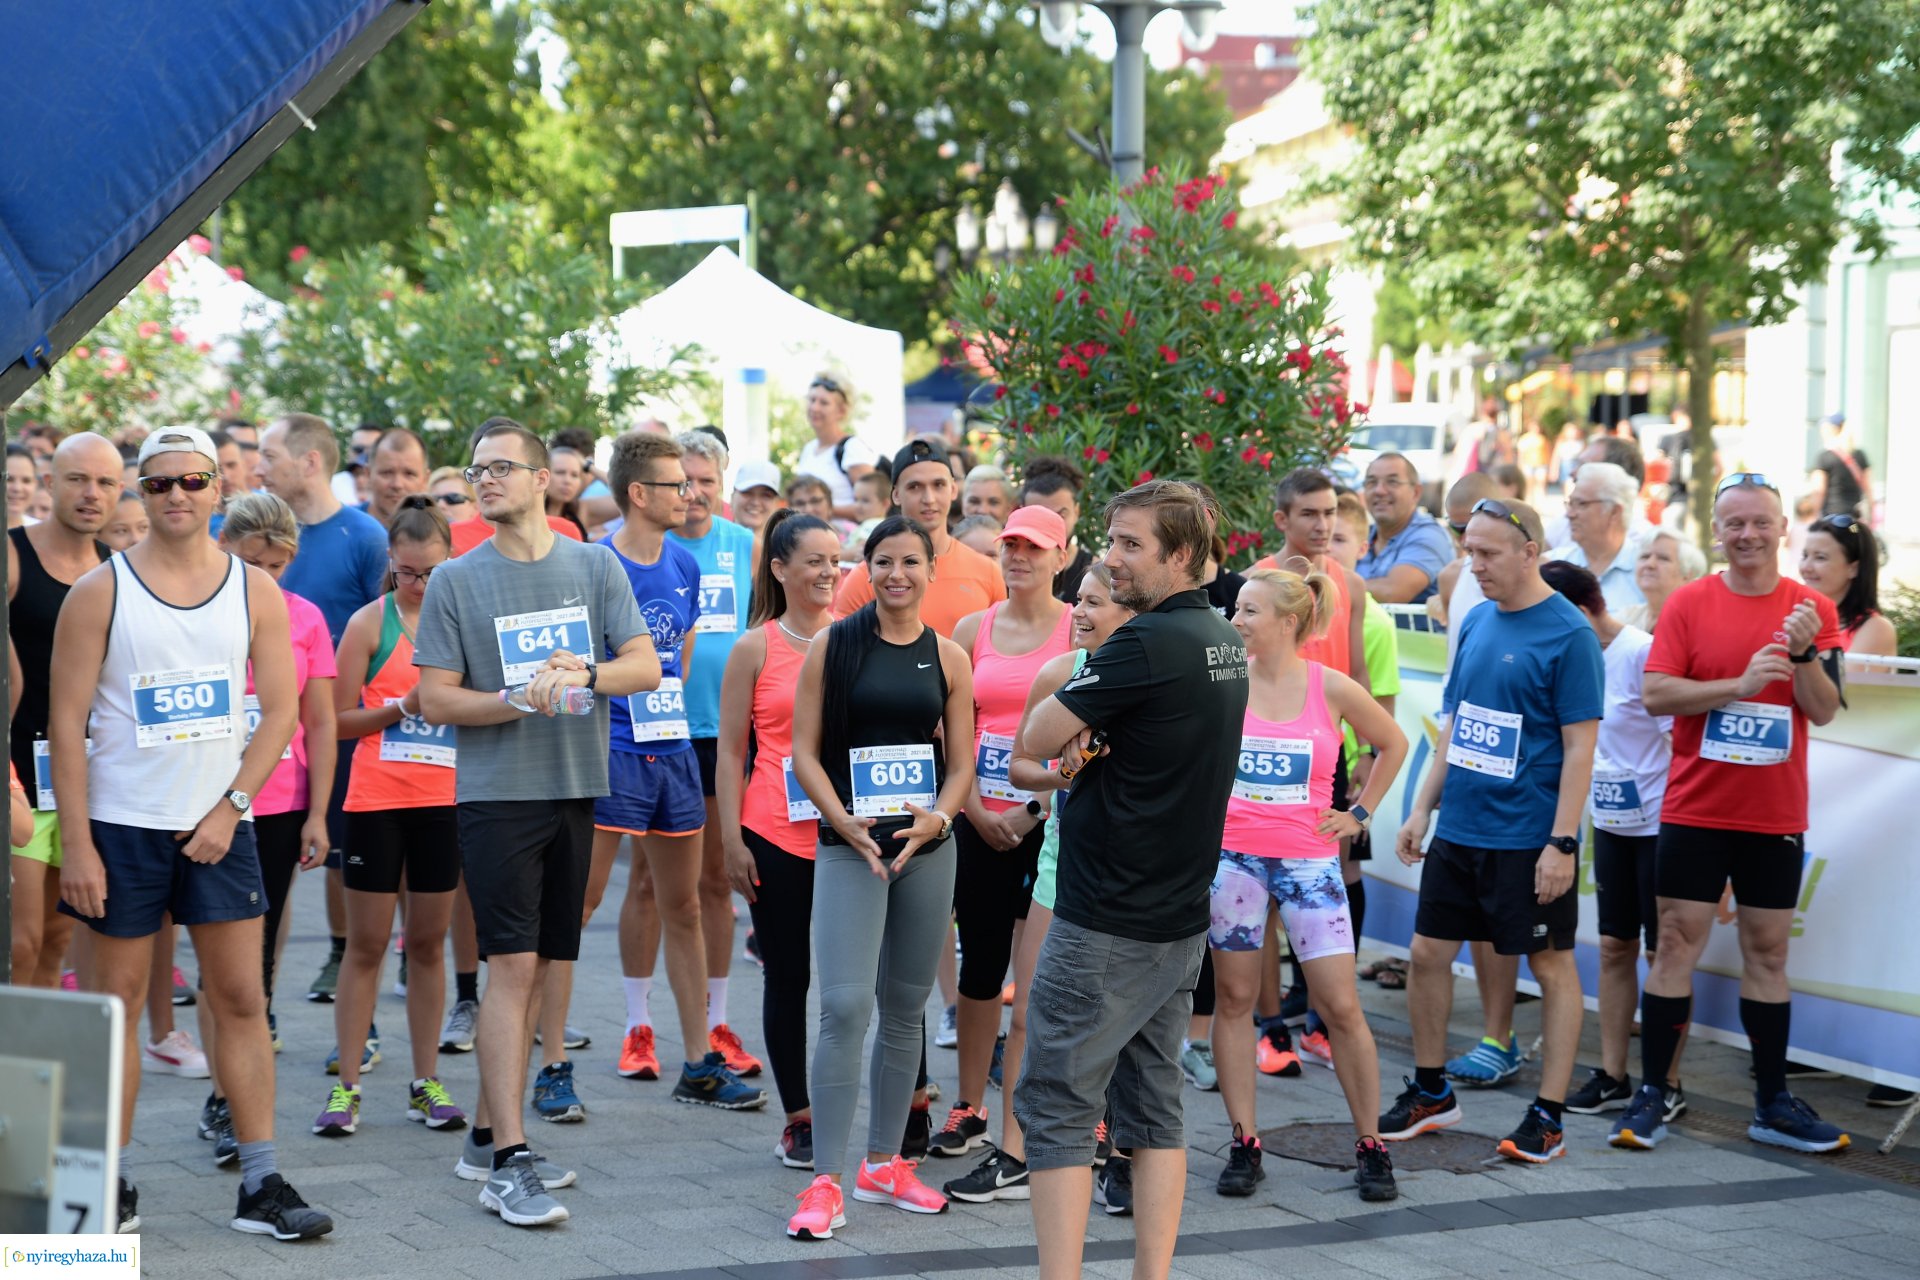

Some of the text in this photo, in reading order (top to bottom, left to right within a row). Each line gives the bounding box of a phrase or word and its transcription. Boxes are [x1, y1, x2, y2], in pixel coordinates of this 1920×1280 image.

[517, 625, 570, 653] 641
[1208, 668, 1237, 682] TIMING
[154, 684, 215, 713] 560
[646, 692, 684, 713] 654
[1459, 718, 1501, 747] 596
[1719, 714, 1774, 739] 507
[870, 761, 923, 787] 603
[1238, 752, 1292, 777] 653
[1594, 783, 1626, 803] 592
